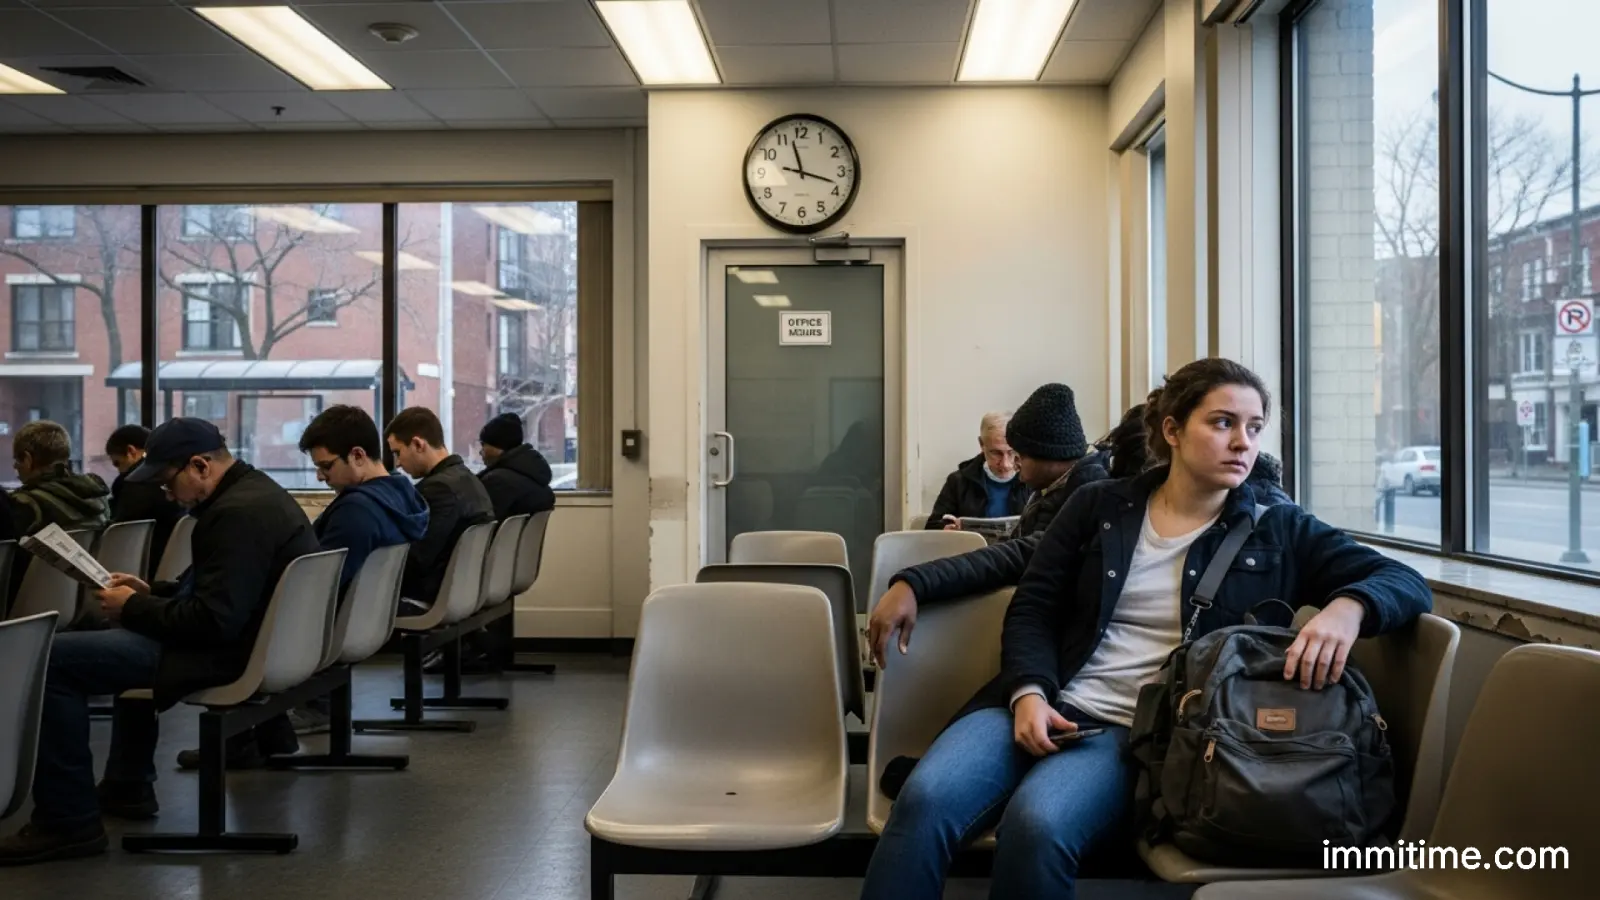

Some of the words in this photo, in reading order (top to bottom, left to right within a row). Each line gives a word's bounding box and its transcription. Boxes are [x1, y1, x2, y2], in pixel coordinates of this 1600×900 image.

[794, 127, 808, 139] 12
[817, 132, 823, 144] 1
[777, 133, 788, 146] 11
[759, 148, 777, 161] 10
[830, 146, 840, 158] 2
[757, 167, 766, 179] 9
[837, 165, 846, 178] 3
[763, 187, 773, 199] 8
[830, 185, 840, 197] 4
[778, 202, 787, 214] 7
[797, 206, 807, 218] 6
[816, 201, 826, 213] 5
